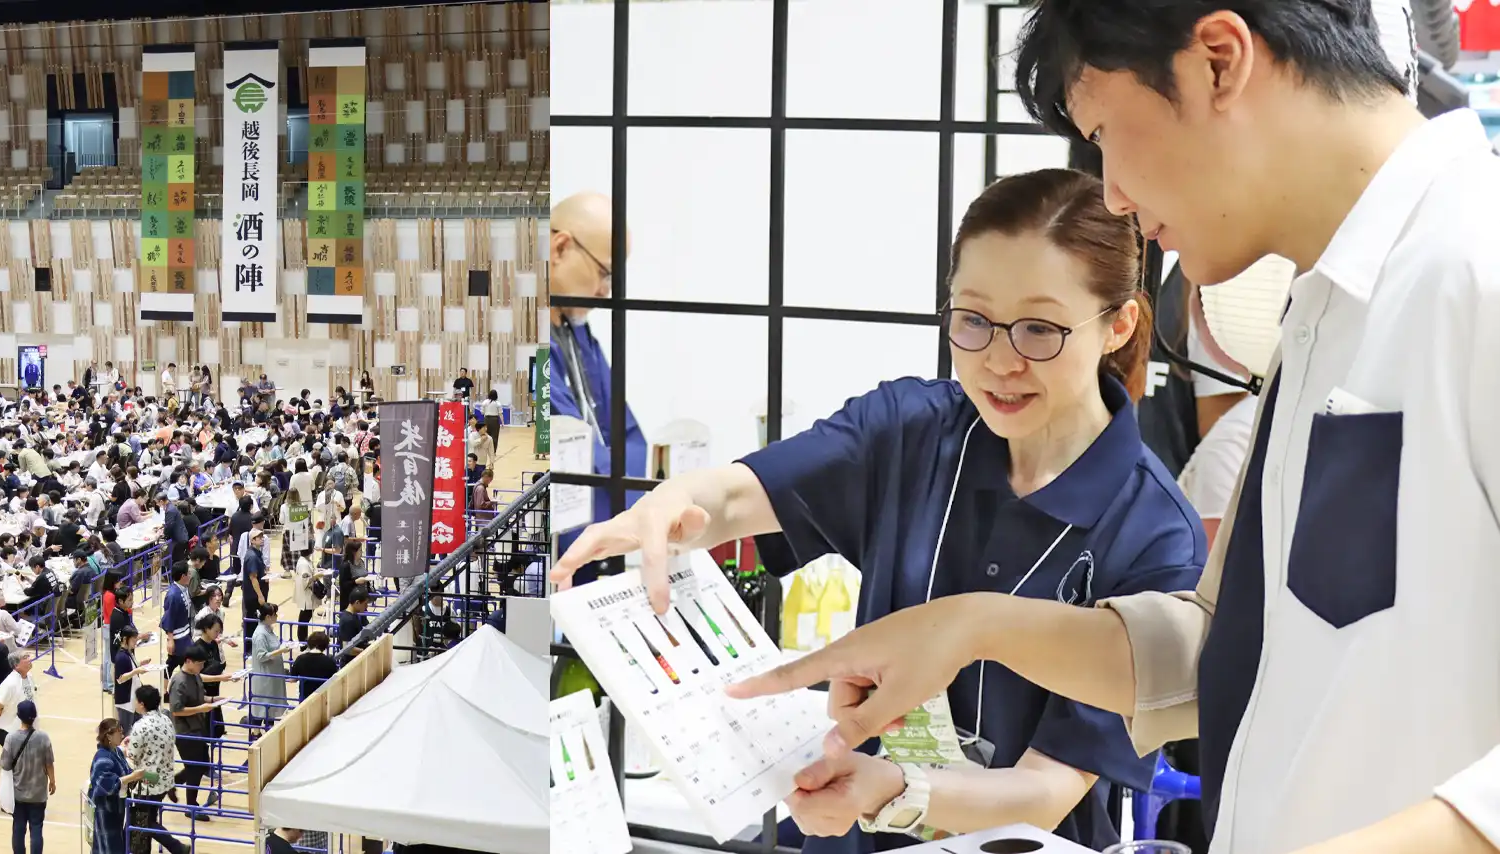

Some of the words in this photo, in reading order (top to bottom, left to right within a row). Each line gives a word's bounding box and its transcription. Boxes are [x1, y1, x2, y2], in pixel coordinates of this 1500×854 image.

[241, 120, 260, 201] 越後長岡
[233, 212, 264, 292] 酒の陣
